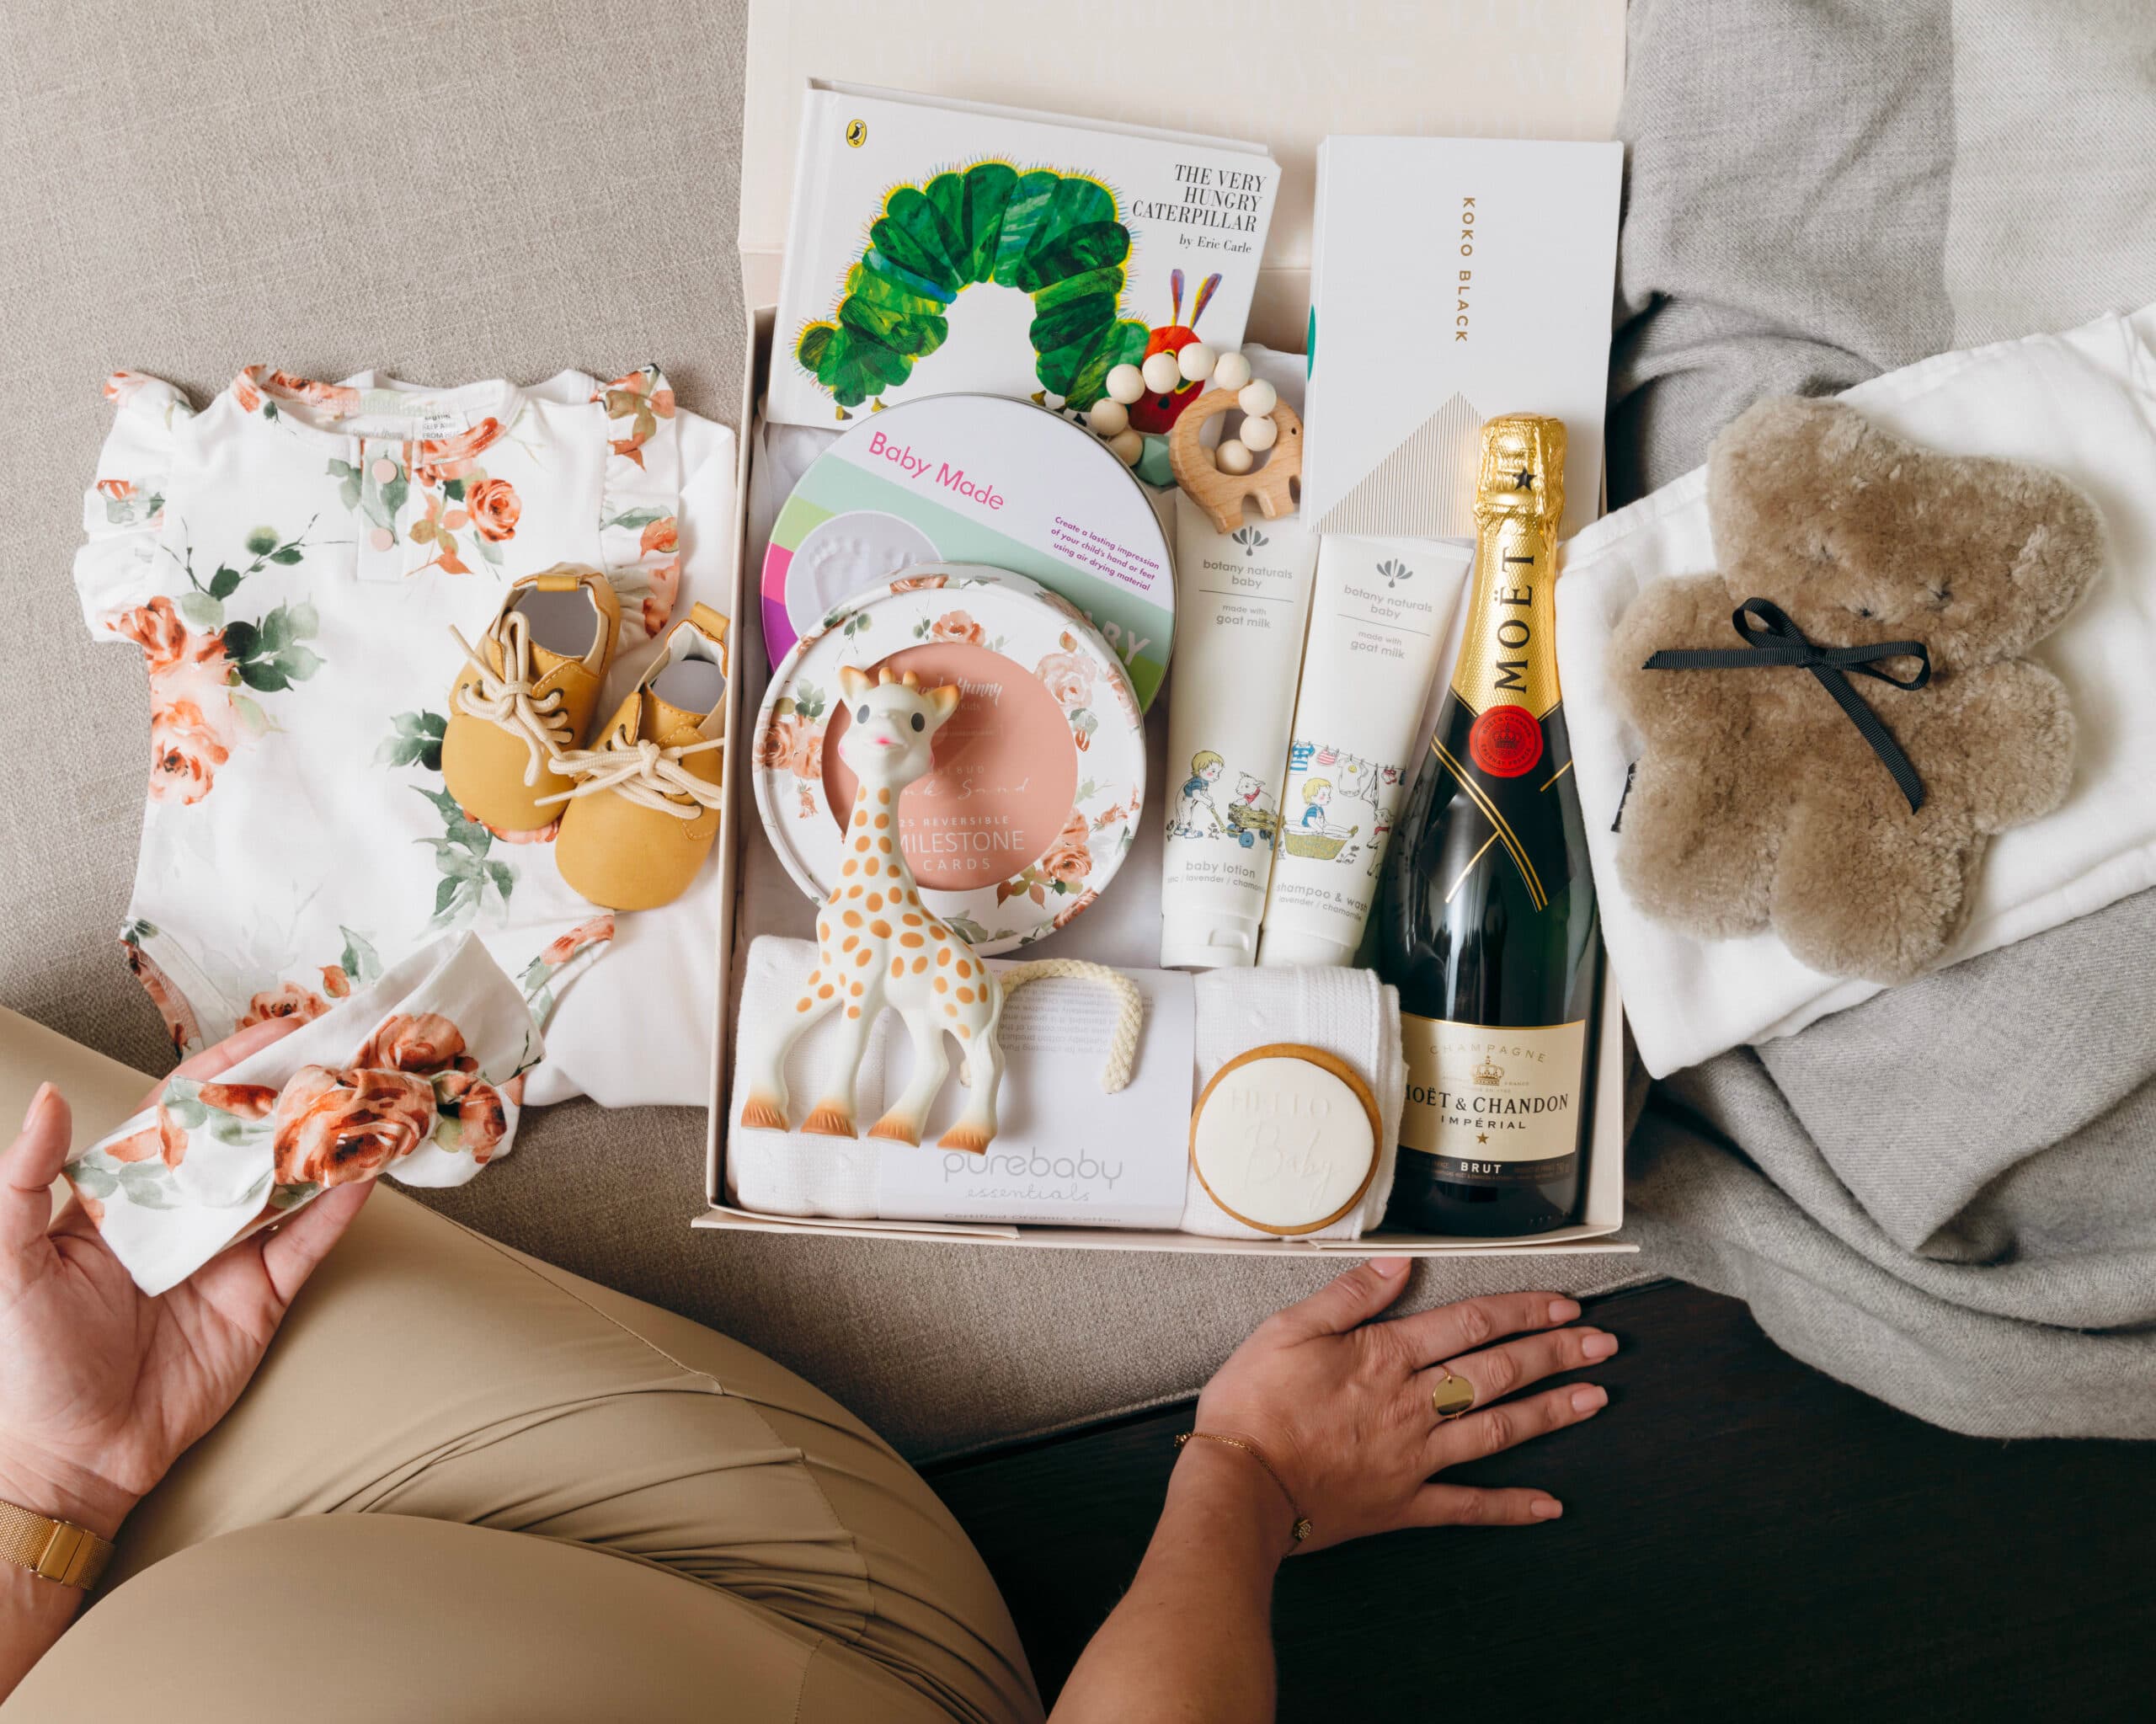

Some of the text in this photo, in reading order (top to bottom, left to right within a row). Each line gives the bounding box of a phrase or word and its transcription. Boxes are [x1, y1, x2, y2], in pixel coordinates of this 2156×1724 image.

[1175, 164, 1267, 192] THE VERY
[1183, 186, 1262, 211] HUNGRY
[1133, 200, 1257, 232] CATERPILLAR
[1179, 233, 1251, 254] by Eric Carle
[1455, 197, 1476, 342] KOKO BLACK
[868, 431, 1004, 510] Baby Made
[1055, 516, 1081, 533] Create
[1089, 531, 1116, 551] lasting
[1117, 545, 1160, 570] impression
[1054, 542, 1151, 591] using air drying material
[1062, 533, 1080, 546] your
[1081, 542, 1105, 558] child's
[1107, 552, 1129, 568] hand
[1139, 568, 1155, 580] feet
[1203, 558, 1294, 579] botany naturals
[1231, 575, 1262, 590] baby
[1222, 603, 1267, 616] made with
[1344, 584, 1433, 614] botany naturals
[1216, 613, 1272, 629] goat milk
[1370, 604, 1401, 621] baby
[1494, 546, 1535, 694] MOËT
[1358, 629, 1402, 647] made with
[1350, 639, 1406, 660] goat milk
[923, 814, 1010, 827] REVERSIBLE
[923, 857, 991, 872] CARDS
[1186, 861, 1256, 878] baby lotion
[1186, 874, 1225, 884] lavender
[1277, 882, 1369, 912] shampoo & wash
[1278, 895, 1314, 907] lavender
[1429, 1043, 1547, 1063] CHAMPAGNE
[1406, 1084, 1568, 1114] OËT & CHANDON
[1441, 1115, 1527, 1129] IMPÉRIAL
[942, 1145, 1123, 1190] purebaby
[1460, 1161, 1502, 1174] BRUT
[965, 1182, 1091, 1202] essentials
